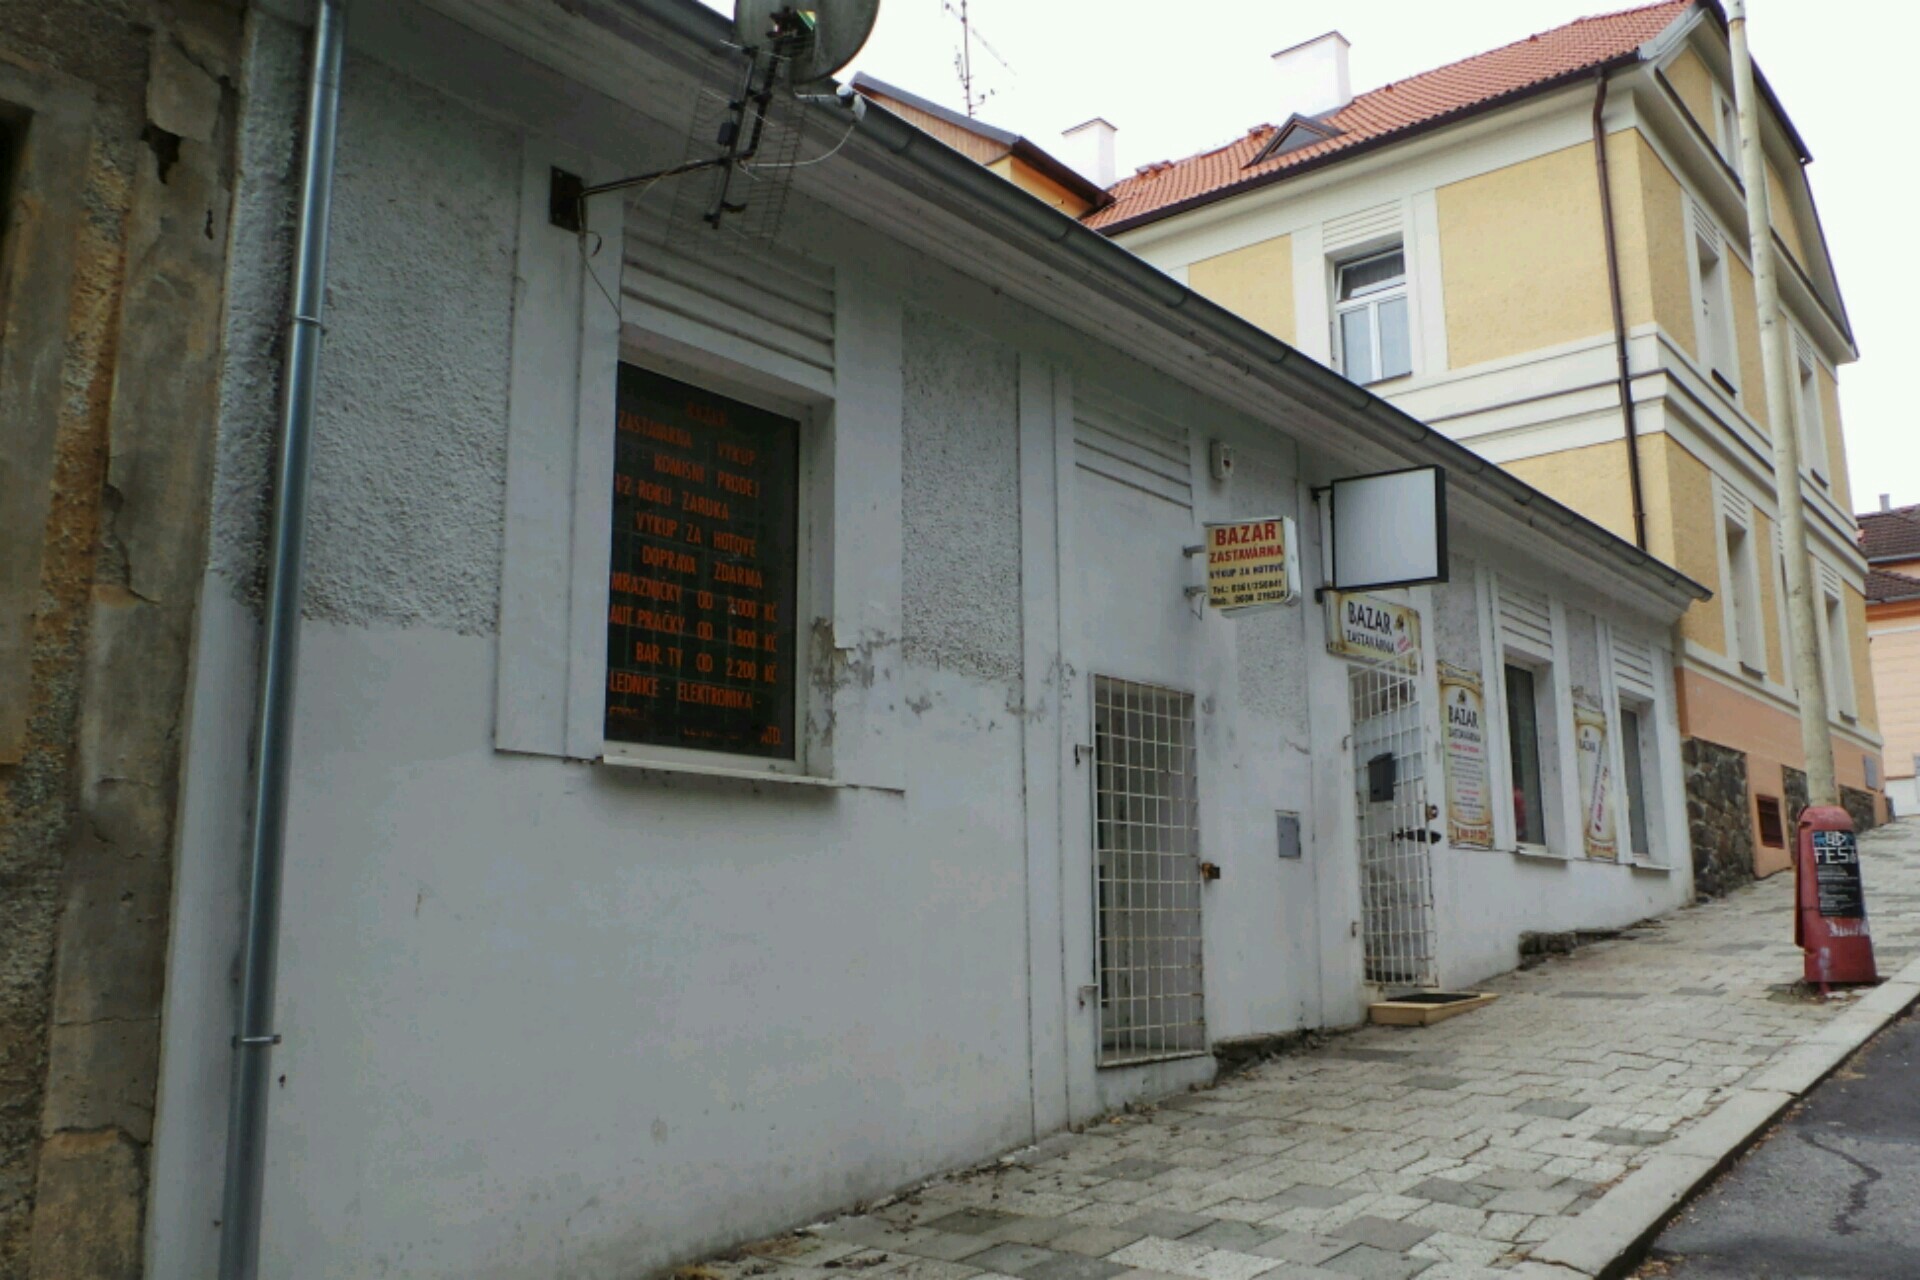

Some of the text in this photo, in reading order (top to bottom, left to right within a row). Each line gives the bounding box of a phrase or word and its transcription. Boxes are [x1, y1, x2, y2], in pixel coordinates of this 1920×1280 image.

[686, 523, 701, 544] ZA
[1215, 523, 1276, 546] BAZAR
[642, 545, 763, 588] DOPRAVA ZDARMA
[697, 591, 713, 609] OD
[1348, 600, 1392, 636] BAZAR
[697, 621, 713, 641] OD
[668, 647, 684, 667] TV
[697, 653, 713, 673] OD
[726, 658, 757, 680] 2.200
[678, 680, 753, 708] ELEKTRONIKA
